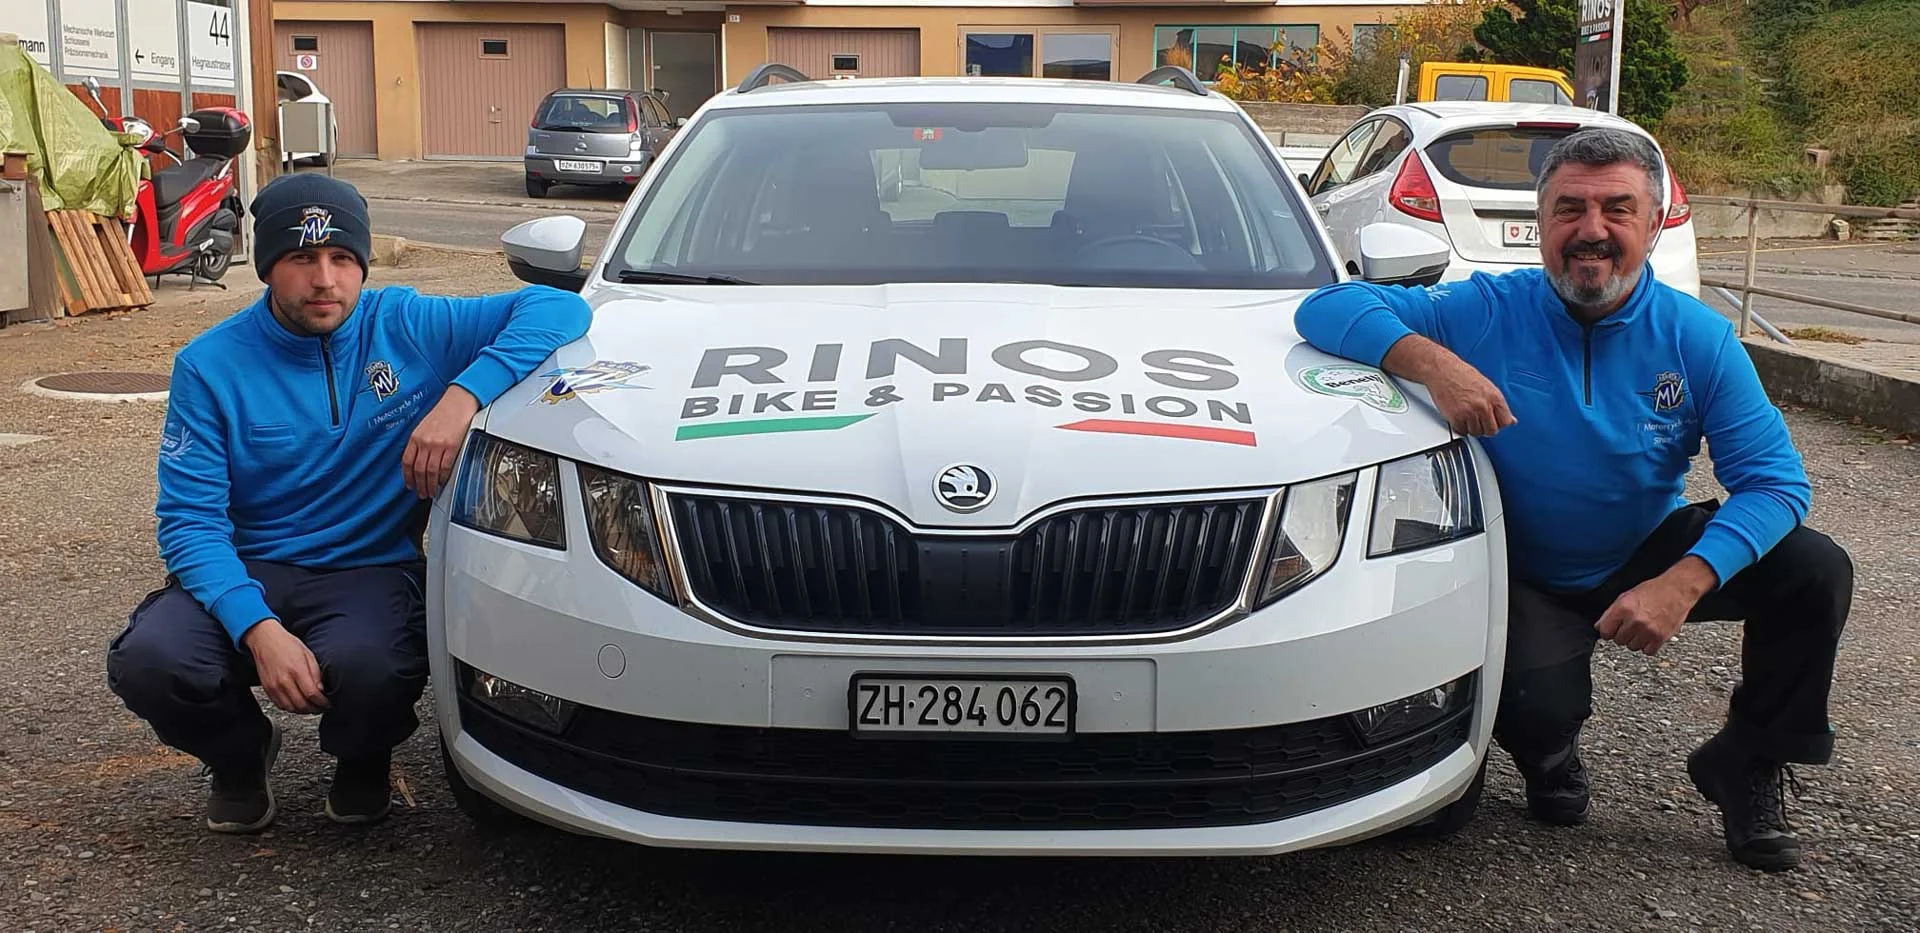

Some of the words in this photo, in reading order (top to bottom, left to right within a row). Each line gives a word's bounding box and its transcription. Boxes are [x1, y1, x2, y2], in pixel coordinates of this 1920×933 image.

[209, 10, 230, 47] 44
[1581, 0, 1611, 23] RINOS
[18, 39, 46, 53] mann
[151, 52, 175, 68] Eingang
[299, 214, 332, 247] MV
[690, 337, 1240, 391] RINOS
[374, 363, 393, 402] MV
[1654, 378, 1684, 413] MV
[680, 389, 838, 420] BIKE
[864, 384, 905, 407] &
[932, 382, 1253, 425] PASSION
